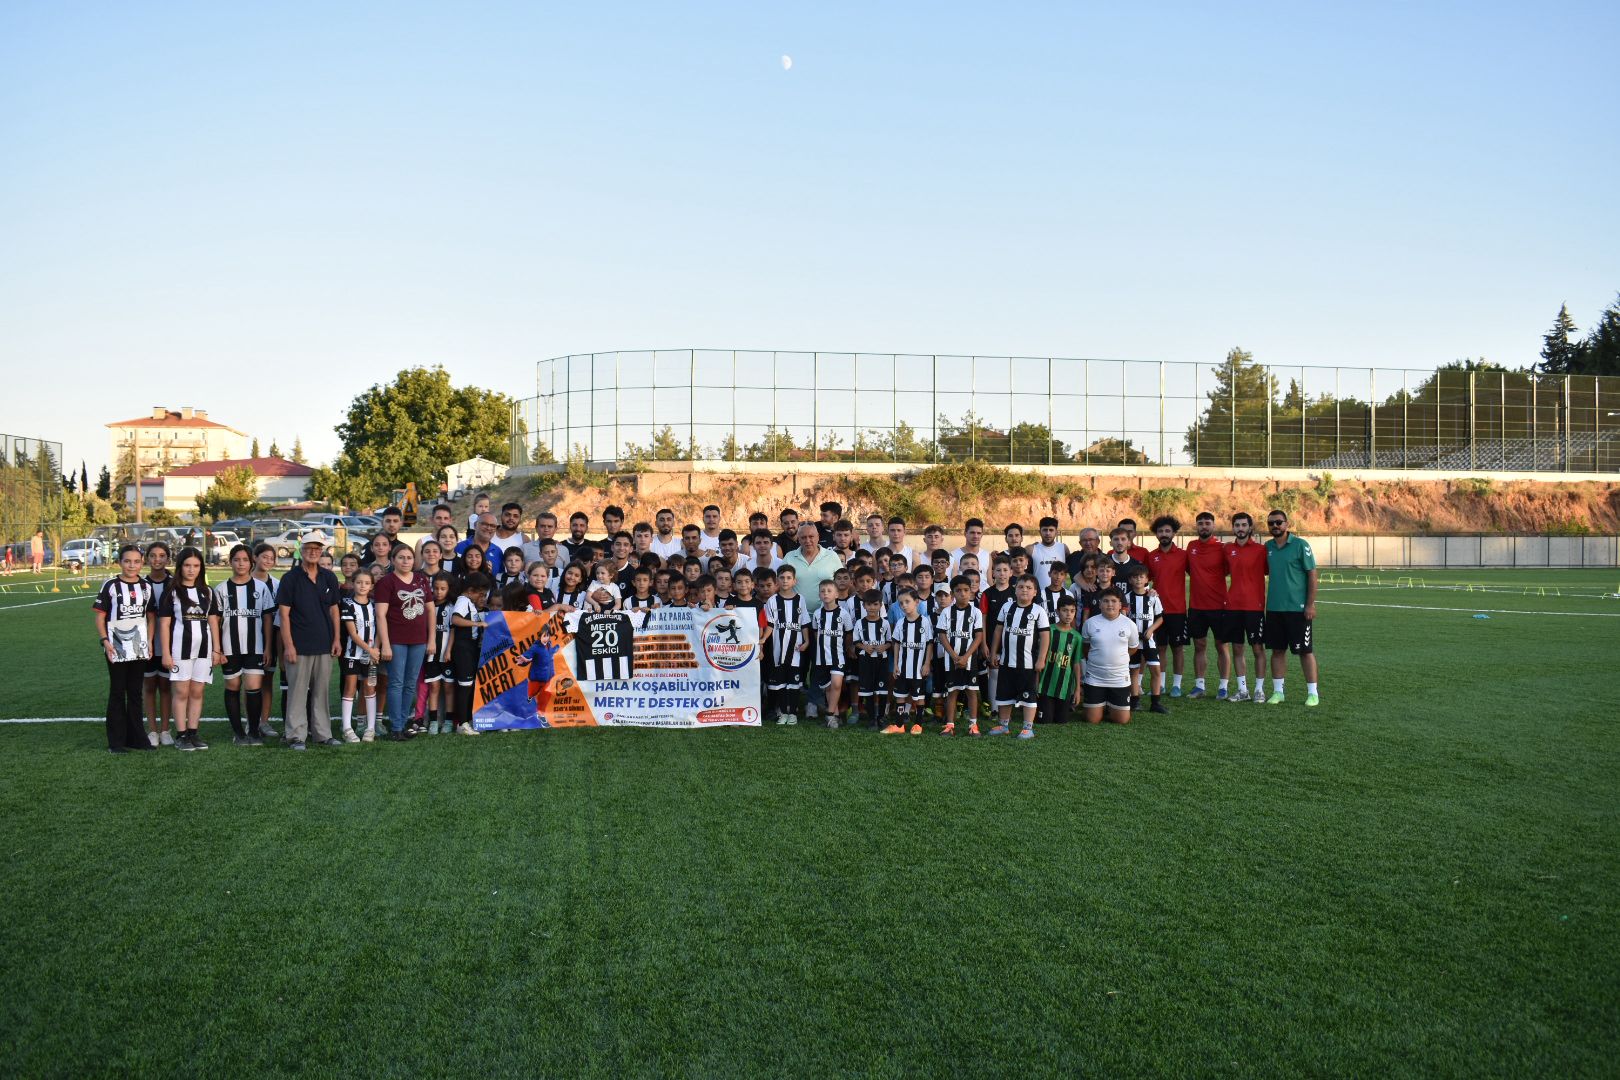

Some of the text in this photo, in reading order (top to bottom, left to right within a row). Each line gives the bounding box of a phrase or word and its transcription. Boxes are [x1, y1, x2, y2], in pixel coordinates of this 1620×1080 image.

[120, 604, 144, 613] beko
[659, 613, 667, 621] AZ
[590, 622, 617, 632] MERT
[590, 629, 619, 648] 20
[591, 647, 619, 655] ESKİCİ
[479, 668, 517, 705] MERT
[595, 679, 740, 695] HALA KOŞABİLİYORKEN
[594, 695, 725, 709] MERT'E DESTEK OL!
